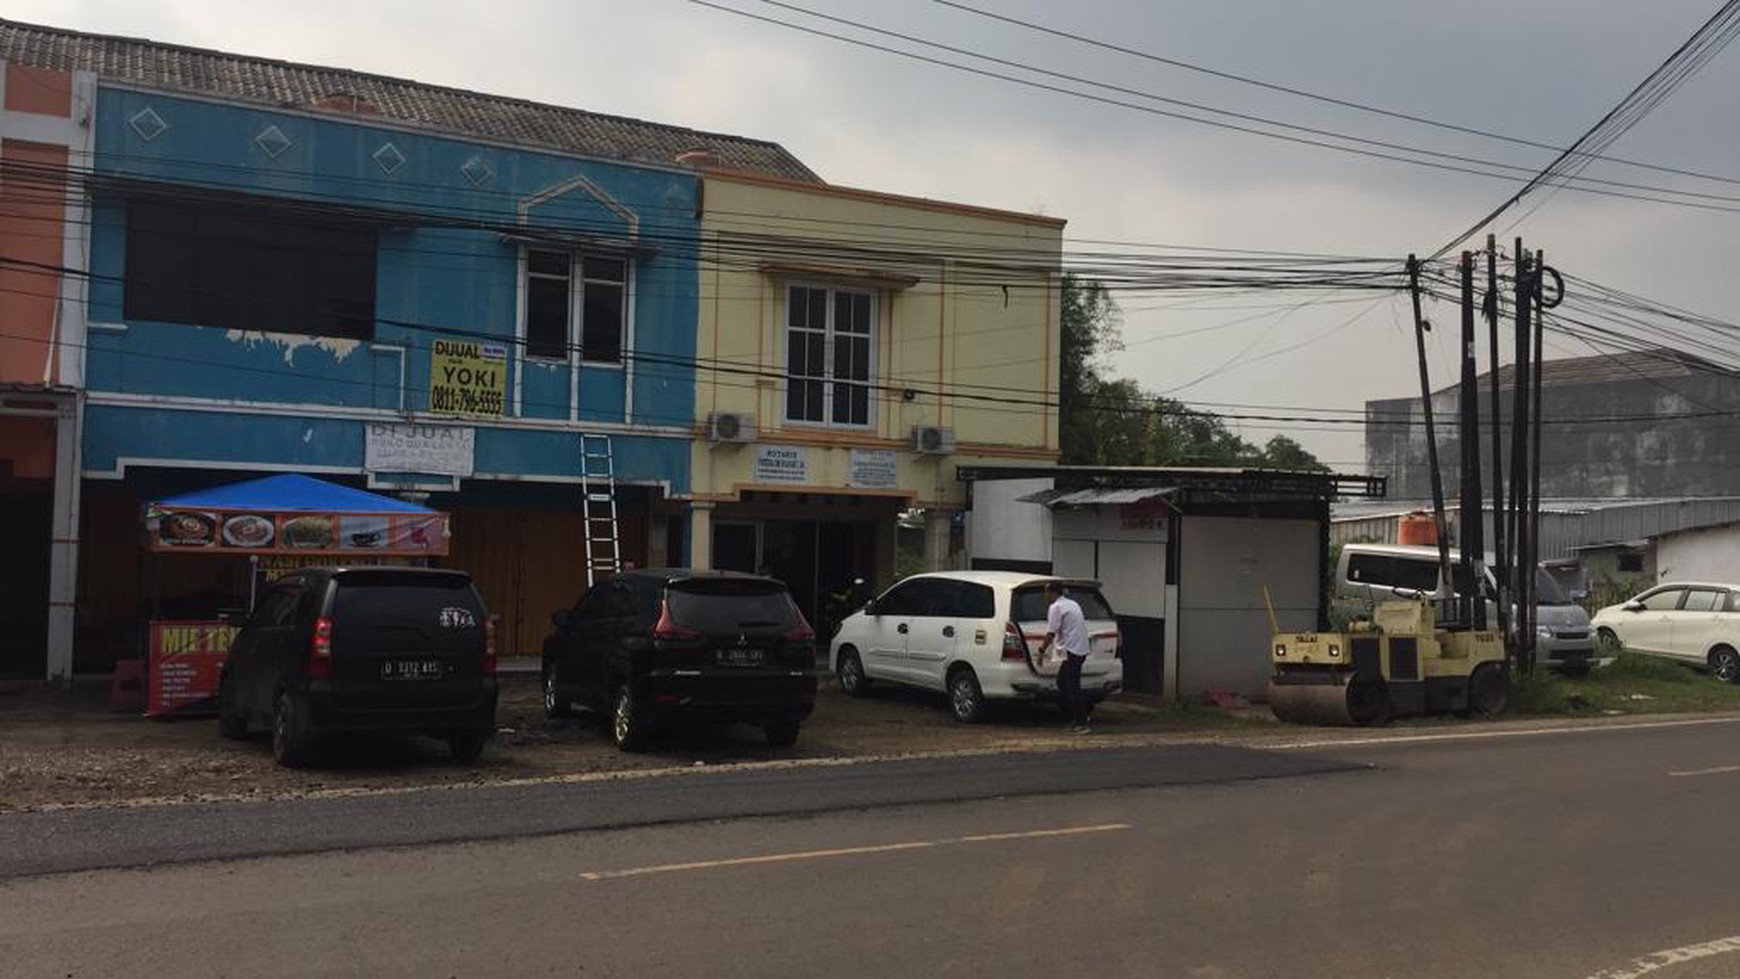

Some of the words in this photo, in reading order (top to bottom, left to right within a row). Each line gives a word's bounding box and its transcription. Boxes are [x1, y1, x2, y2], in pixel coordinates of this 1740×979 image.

[435, 341, 480, 359] DIJUAL
[443, 366, 496, 388] YOKI
[162, 627, 197, 653] MIE
